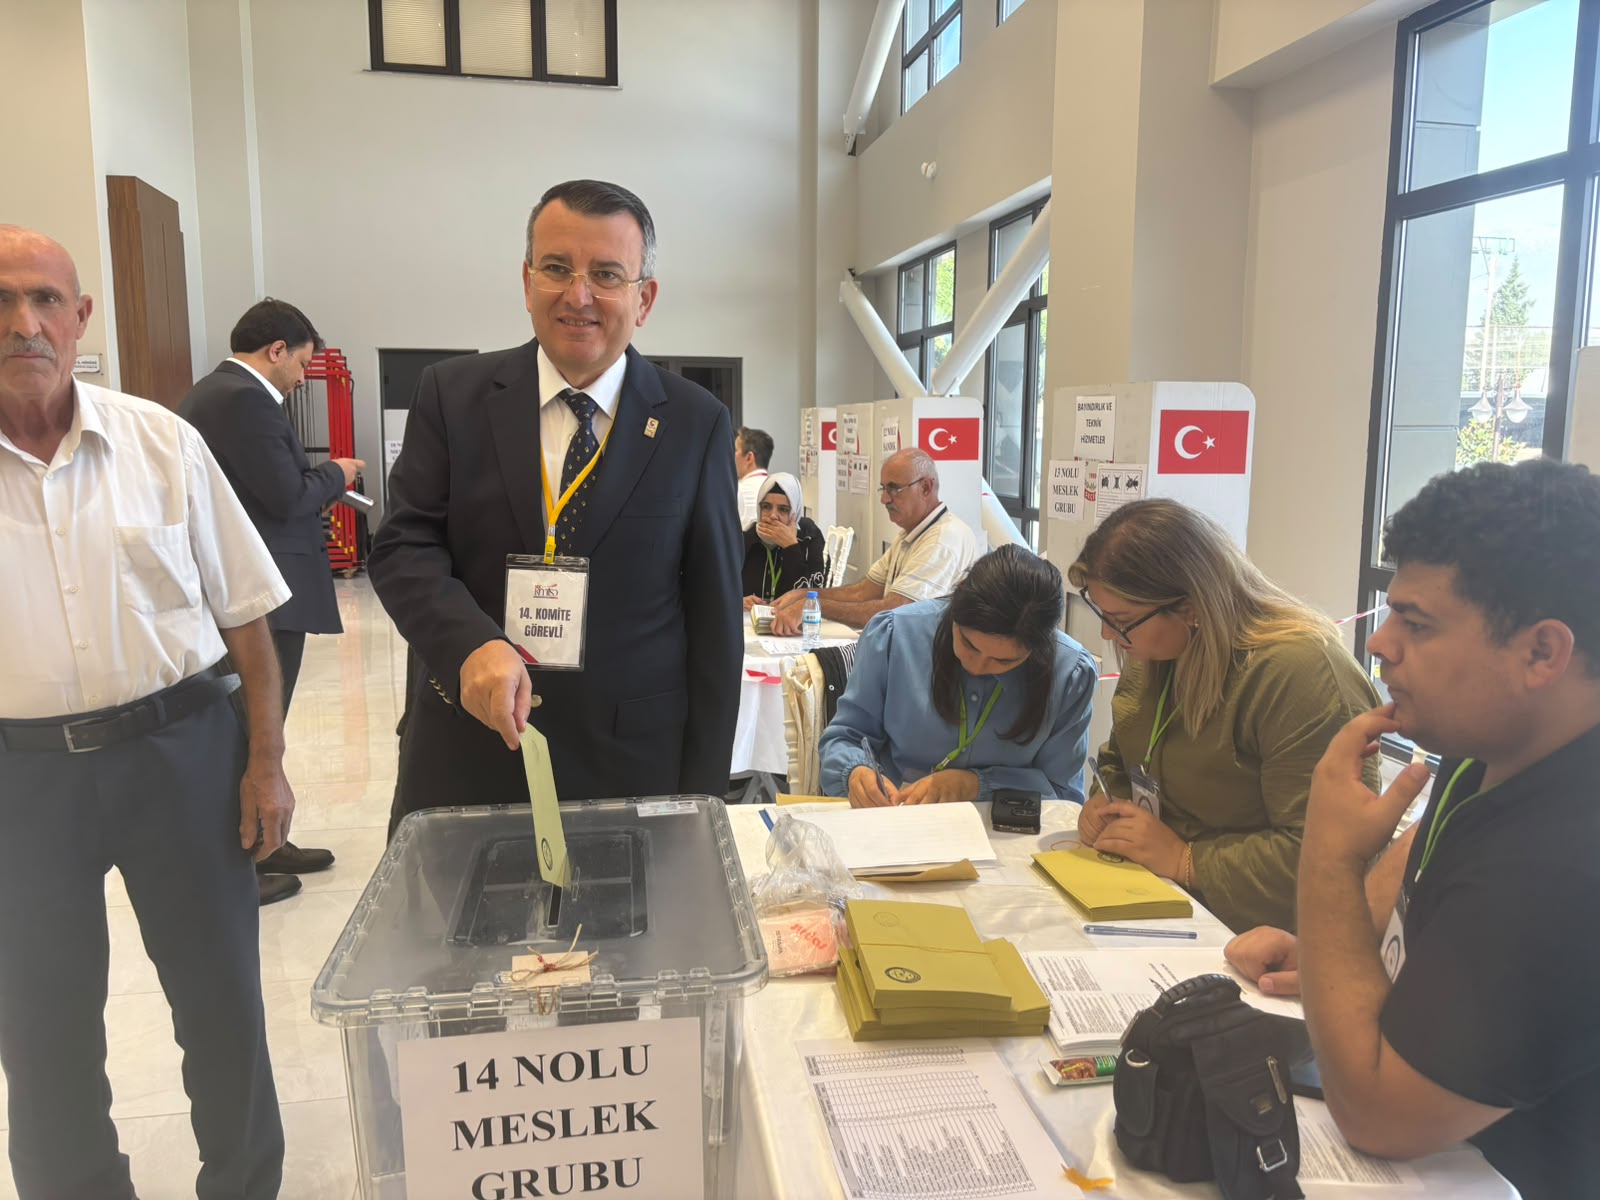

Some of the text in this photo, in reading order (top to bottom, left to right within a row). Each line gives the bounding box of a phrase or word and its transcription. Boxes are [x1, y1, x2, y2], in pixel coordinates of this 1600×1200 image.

[1106, 402, 1113, 411] VE
[1080, 433, 1106, 445] HİZMETLER
[1054, 467, 1079, 478] 13 NOLU
[1053, 484, 1079, 496] MESLEK
[1054, 502, 1077, 513] GRUBU
[519, 607, 571, 621] 14. KOMİTE
[524, 623, 563, 638] GÖREVLİ
[453, 1044, 652, 1093] 14 NOLU
[450, 1100, 659, 1151] MESLEK
[472, 1157, 643, 1200] GRUBU
